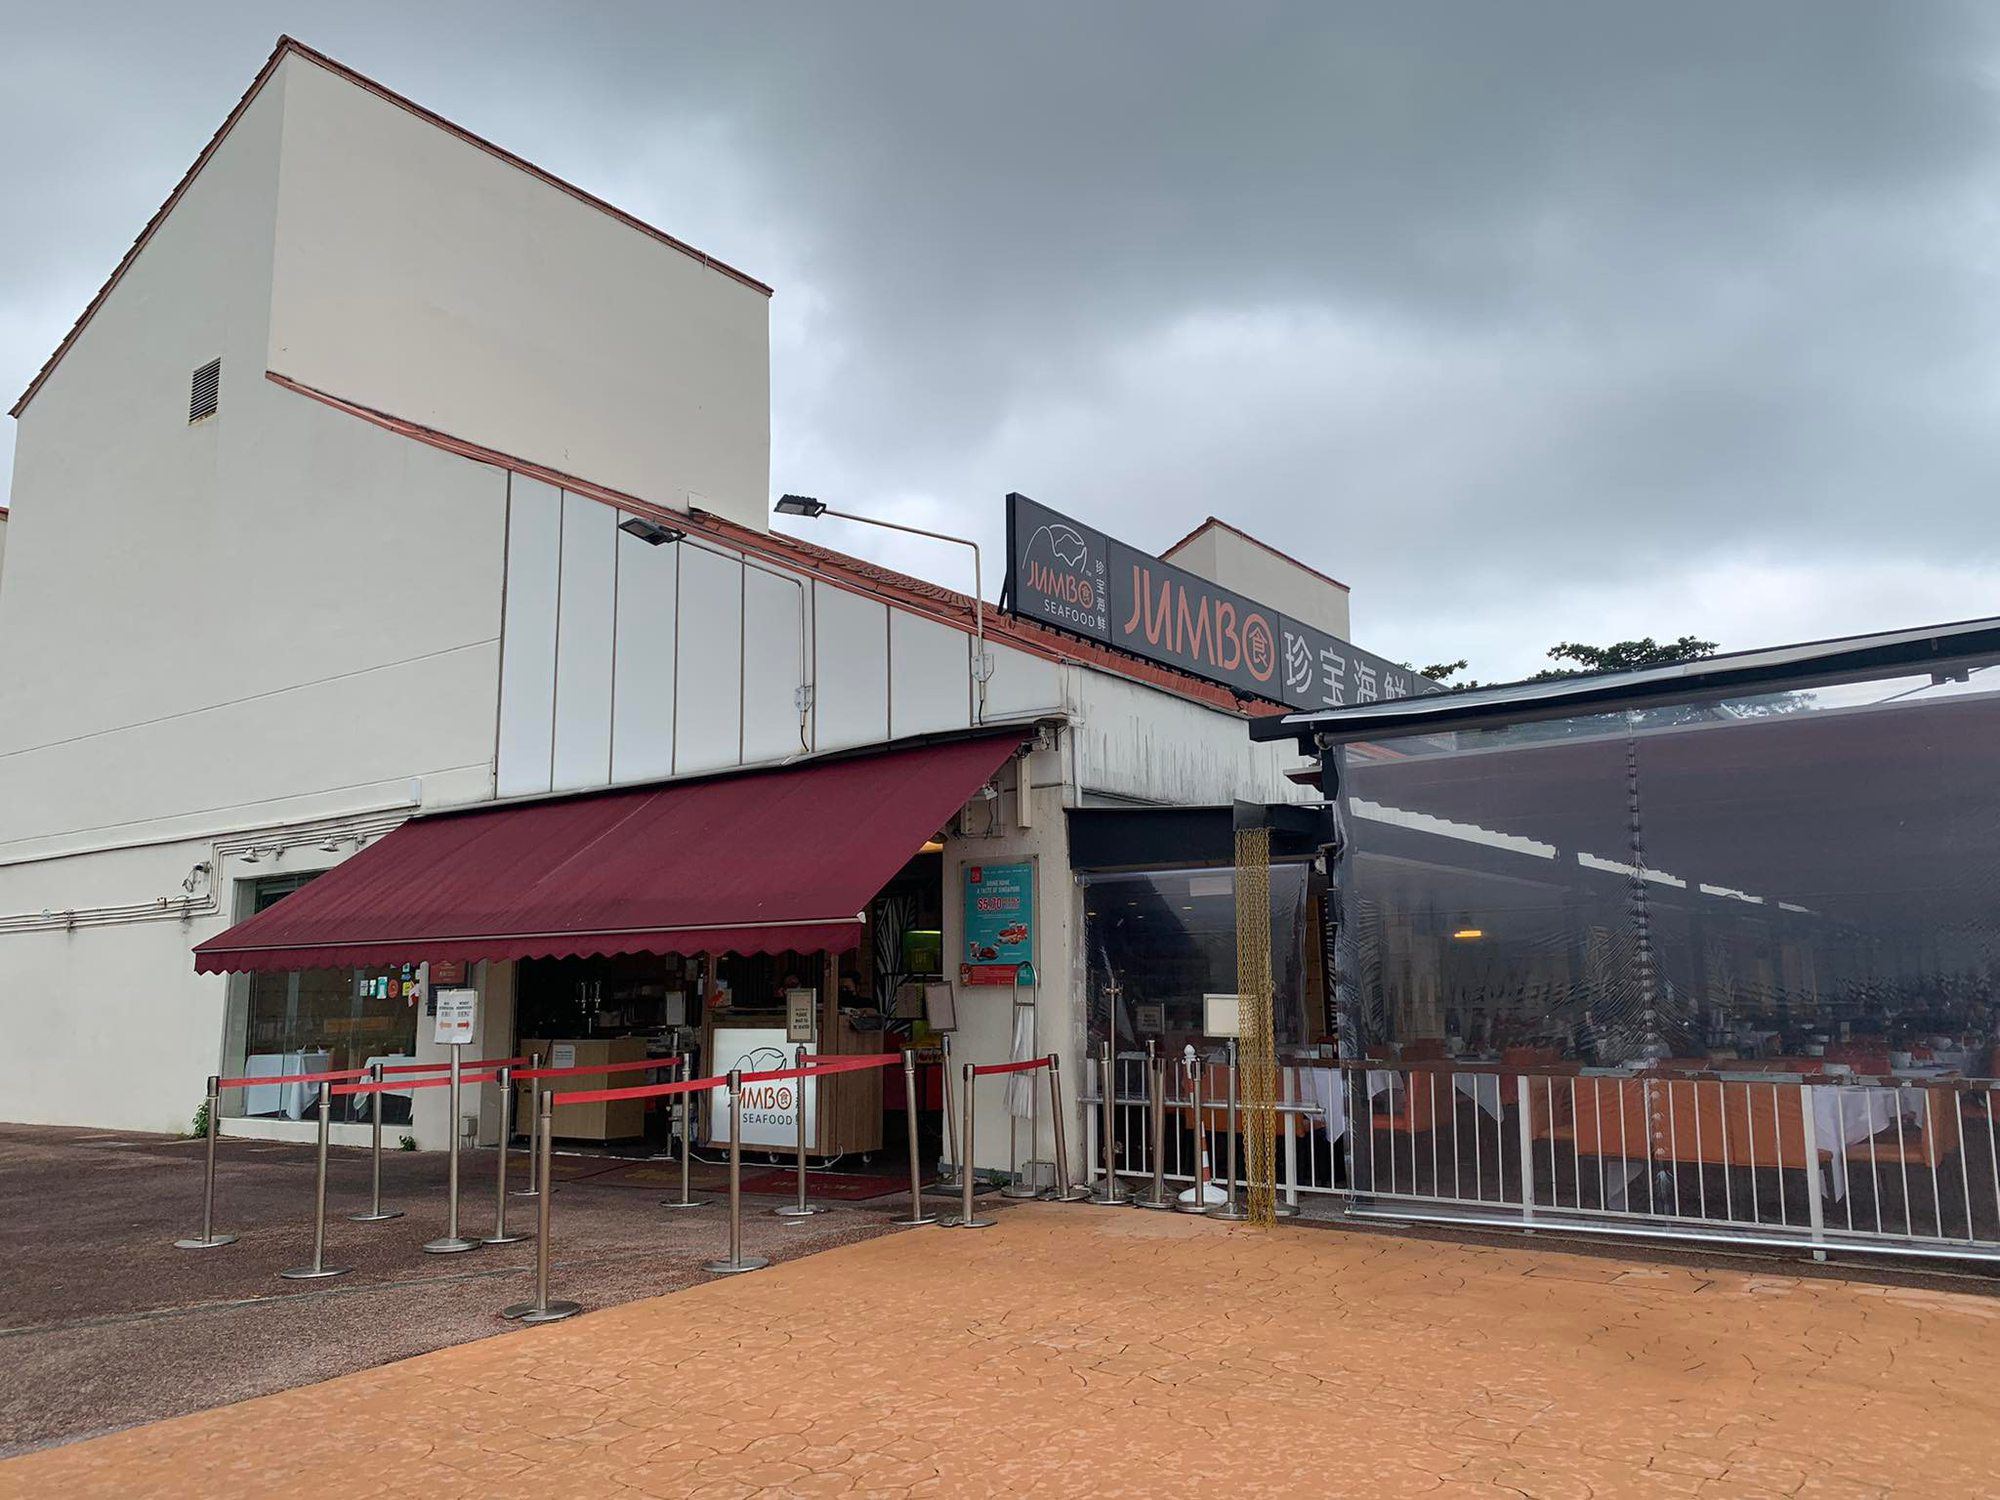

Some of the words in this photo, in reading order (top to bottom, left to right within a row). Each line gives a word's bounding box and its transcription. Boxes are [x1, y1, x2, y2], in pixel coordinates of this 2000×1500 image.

[1026, 560, 1094, 609] JUMBO
[1044, 599, 1095, 627] SEAFOOD
[1124, 565, 1275, 682] JUMBO
[728, 1087, 792, 1110] MBO
[743, 1113, 792, 1125] SEAFOOD
